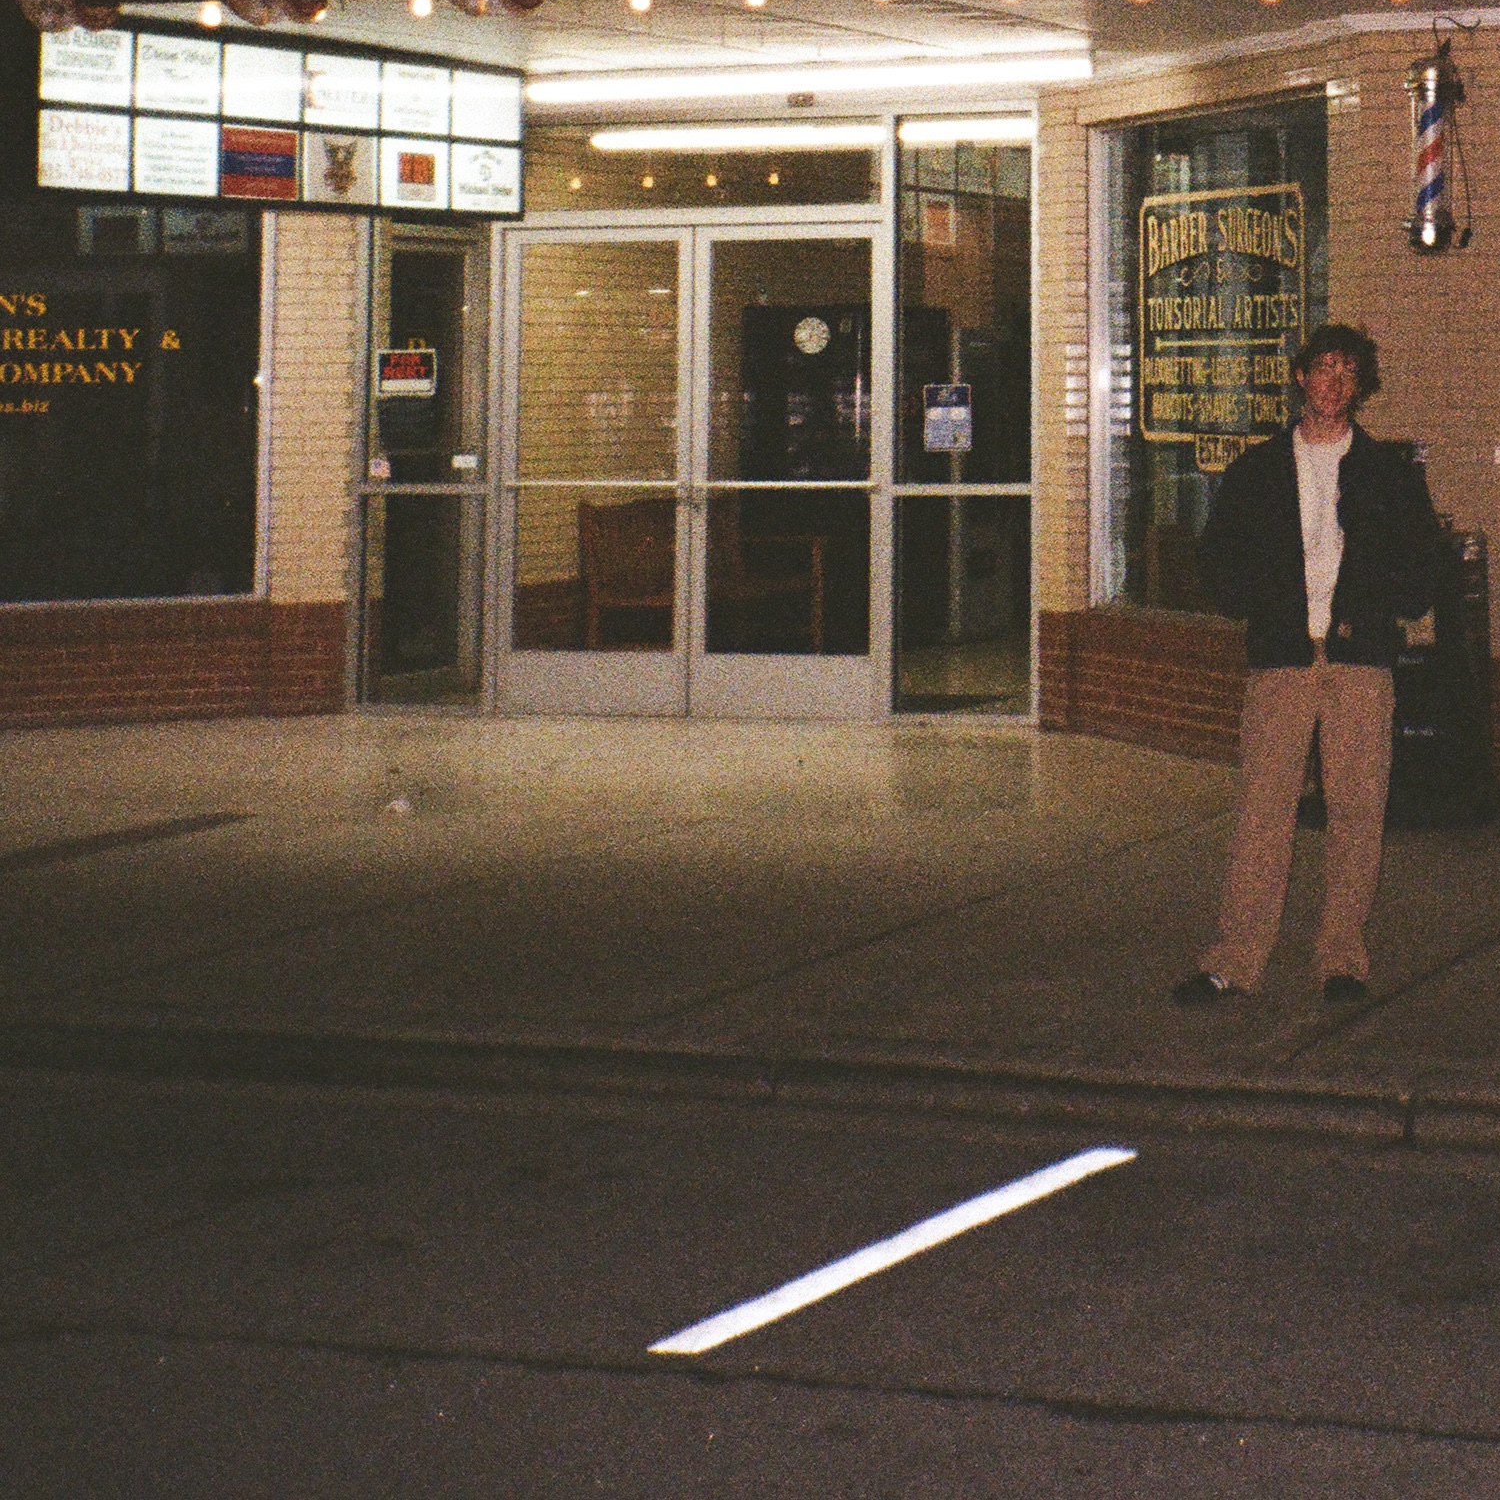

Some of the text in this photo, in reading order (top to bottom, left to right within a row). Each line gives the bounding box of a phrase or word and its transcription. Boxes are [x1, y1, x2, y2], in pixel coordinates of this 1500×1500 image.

[1148, 206, 1298, 276] BARBER SURGEONS
[1147, 293, 1299, 331] TONSORIAL ARTISTS
[3, 328, 181, 350] REALTY &
